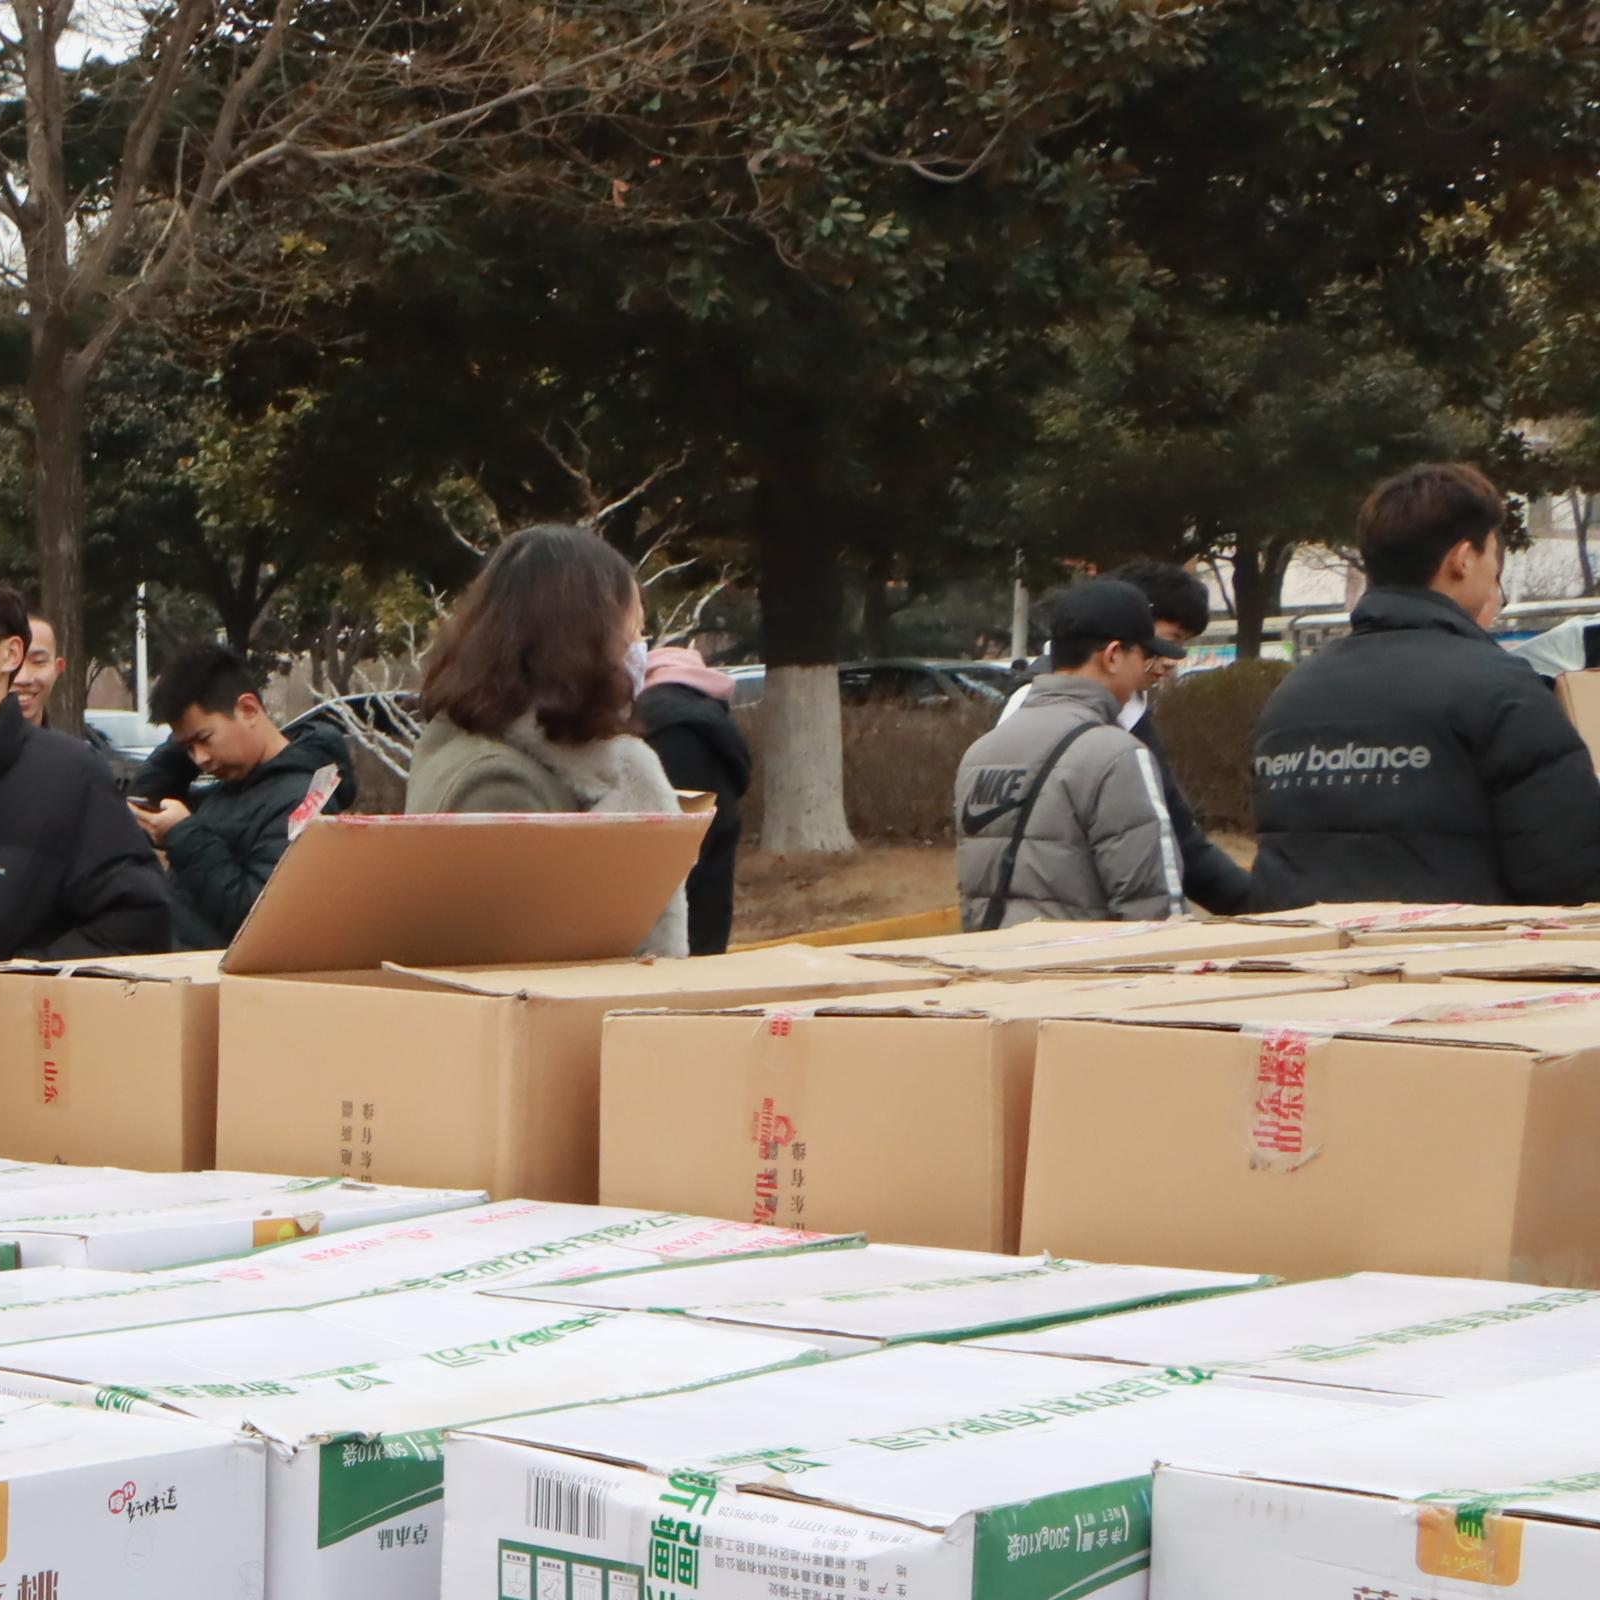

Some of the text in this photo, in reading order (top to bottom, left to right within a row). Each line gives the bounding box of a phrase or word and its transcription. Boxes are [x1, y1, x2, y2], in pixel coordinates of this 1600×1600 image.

[1256, 742, 1431, 777] new balance
[972, 768, 1025, 806] NIKE
[1269, 774, 1401, 790] AUTHENTIC
